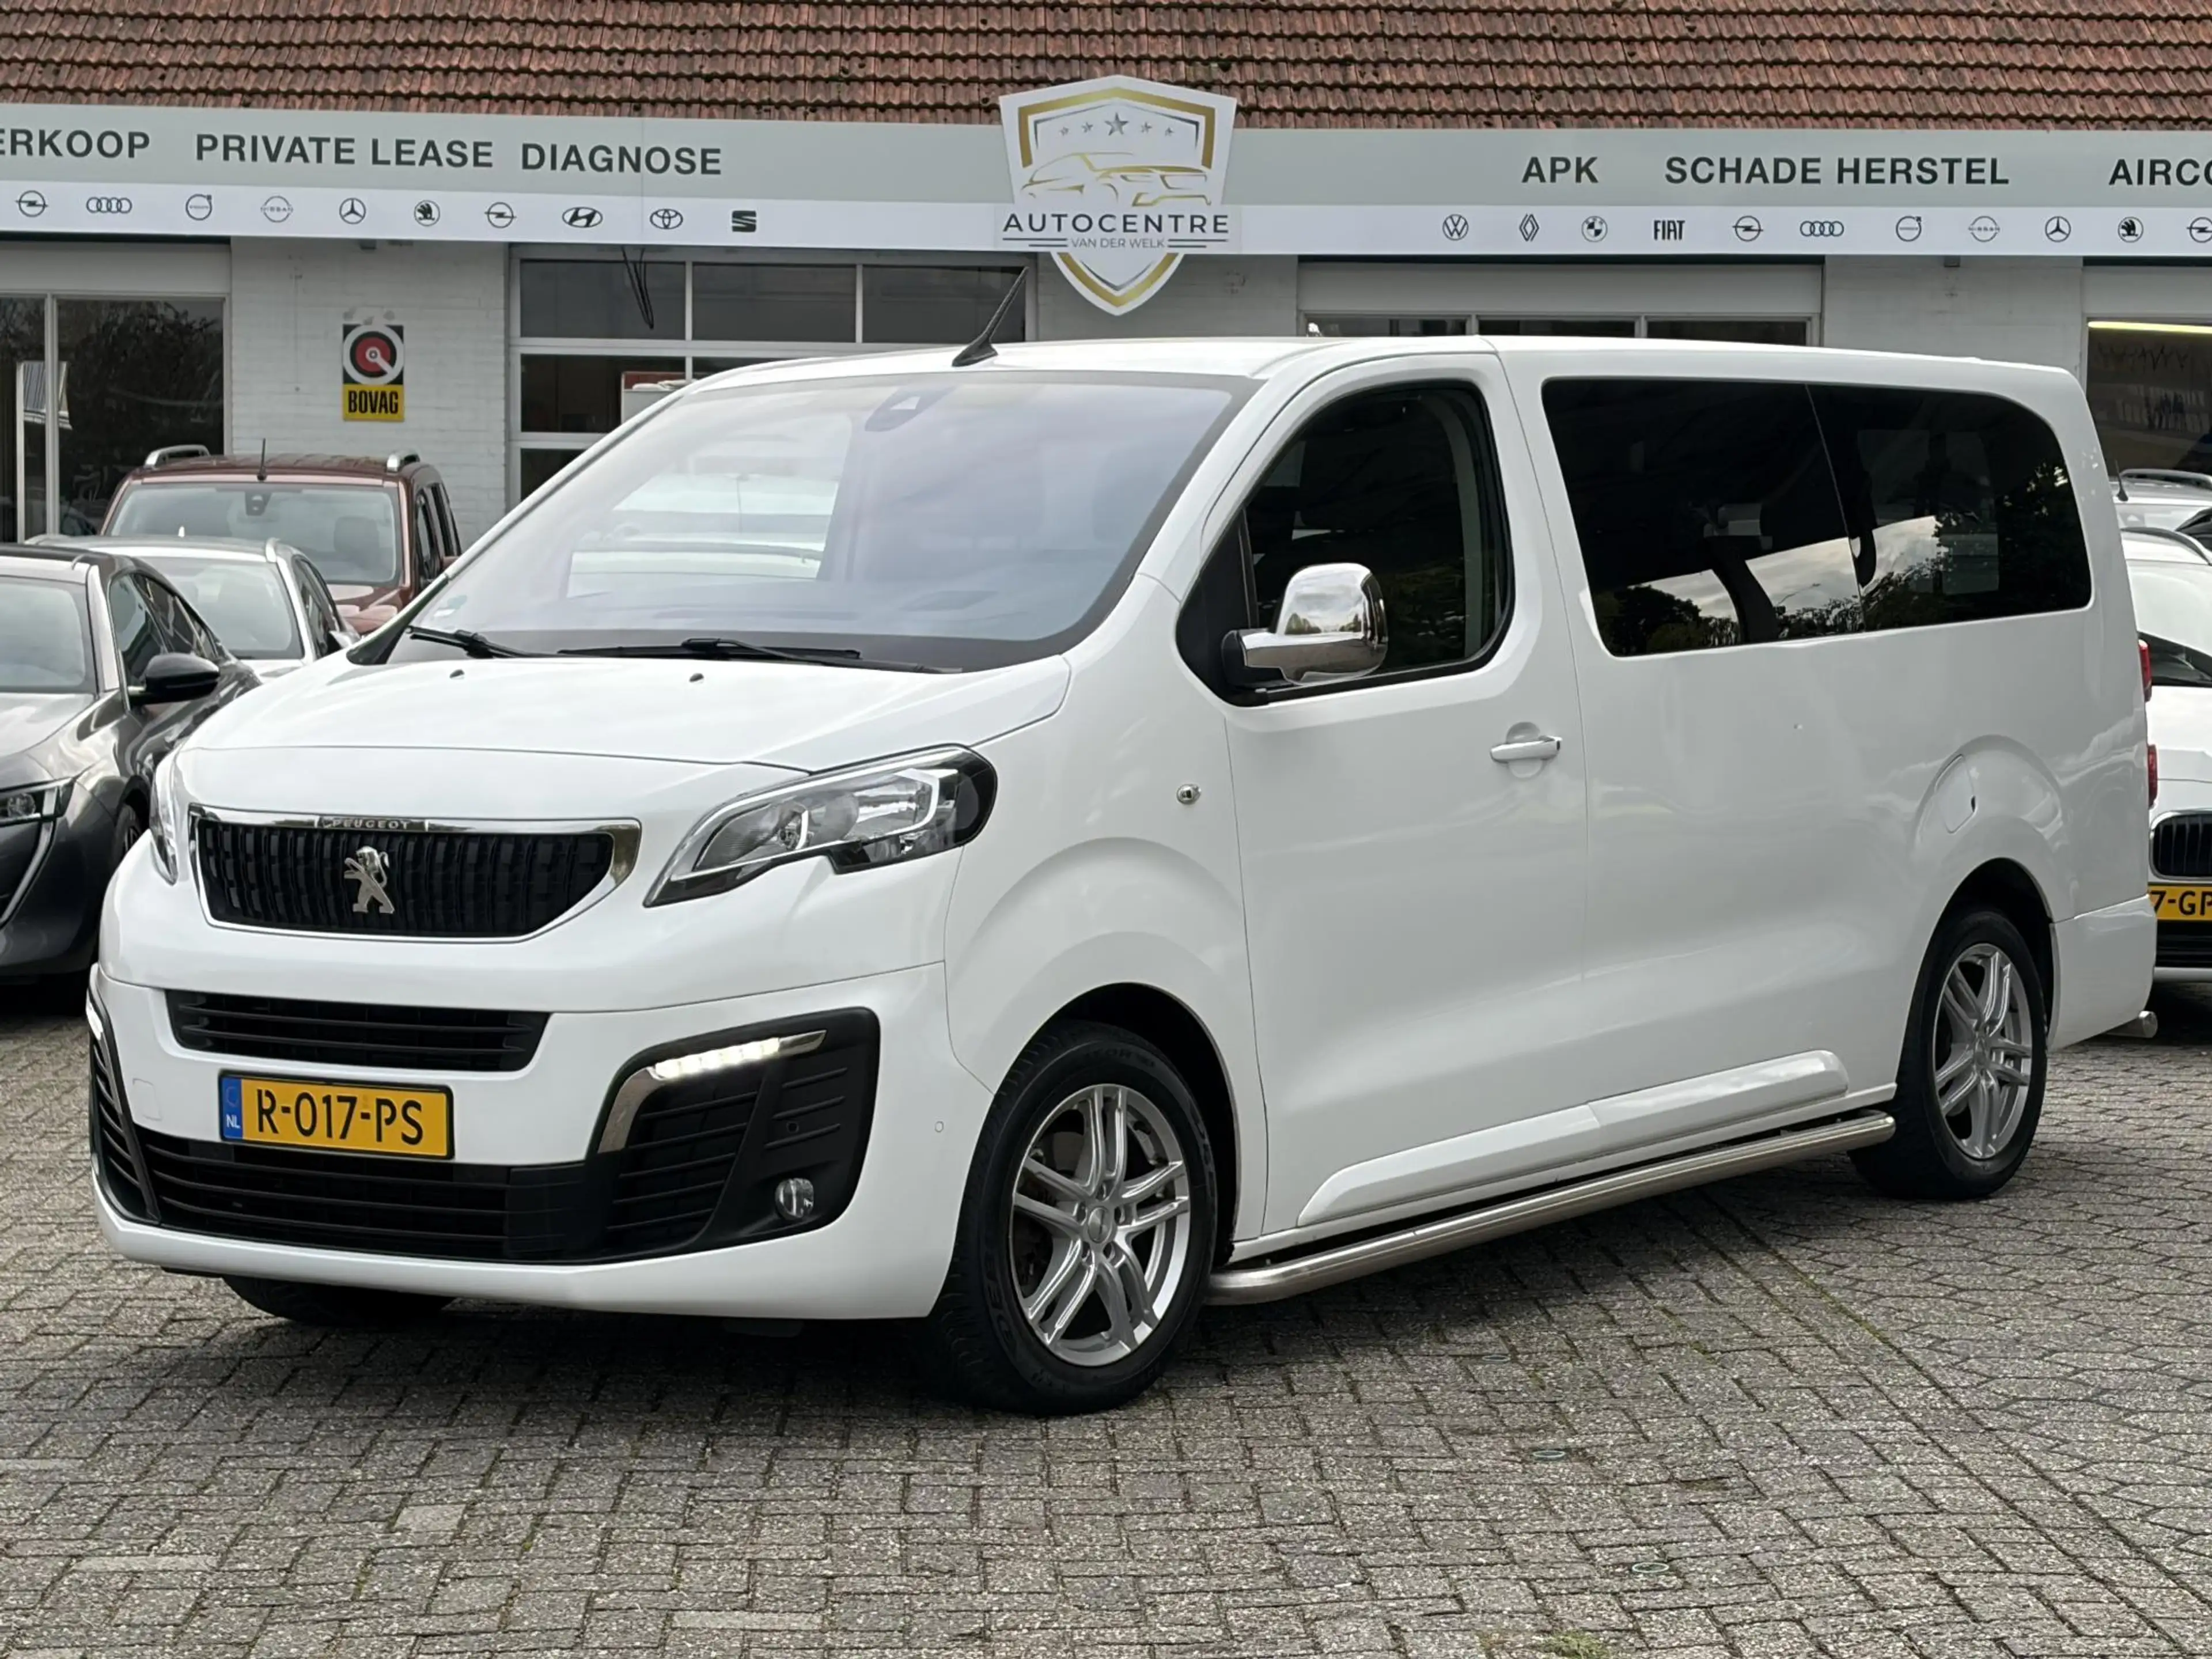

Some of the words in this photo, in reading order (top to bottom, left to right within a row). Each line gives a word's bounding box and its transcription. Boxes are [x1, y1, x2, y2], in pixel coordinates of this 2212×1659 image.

[0, 128, 150, 158] RKOOP
[196, 134, 355, 165] PRIVATE
[371, 138, 493, 168] LEASE
[521, 143, 721, 175] DIAGNOSE
[1521, 156, 1599, 184] APK
[1665, 156, 1822, 184] SCHADE
[1836, 157, 2010, 185] HERSTEL
[2108, 158, 2212, 186] AIRC
[1002, 213, 1229, 233] AUTOCENTRE
[1653, 219, 1685, 241] FIAT
[1071, 237, 1096, 248] VAN
[1100, 238, 1126, 249] DER
[1129, 238, 1166, 249] WELK
[347, 390, 399, 415] BOVAG
[332, 818, 408, 830] PEUGEOT
[225, 1113, 241, 1129] NL
[256, 1088, 423, 1146] R-017-PS
